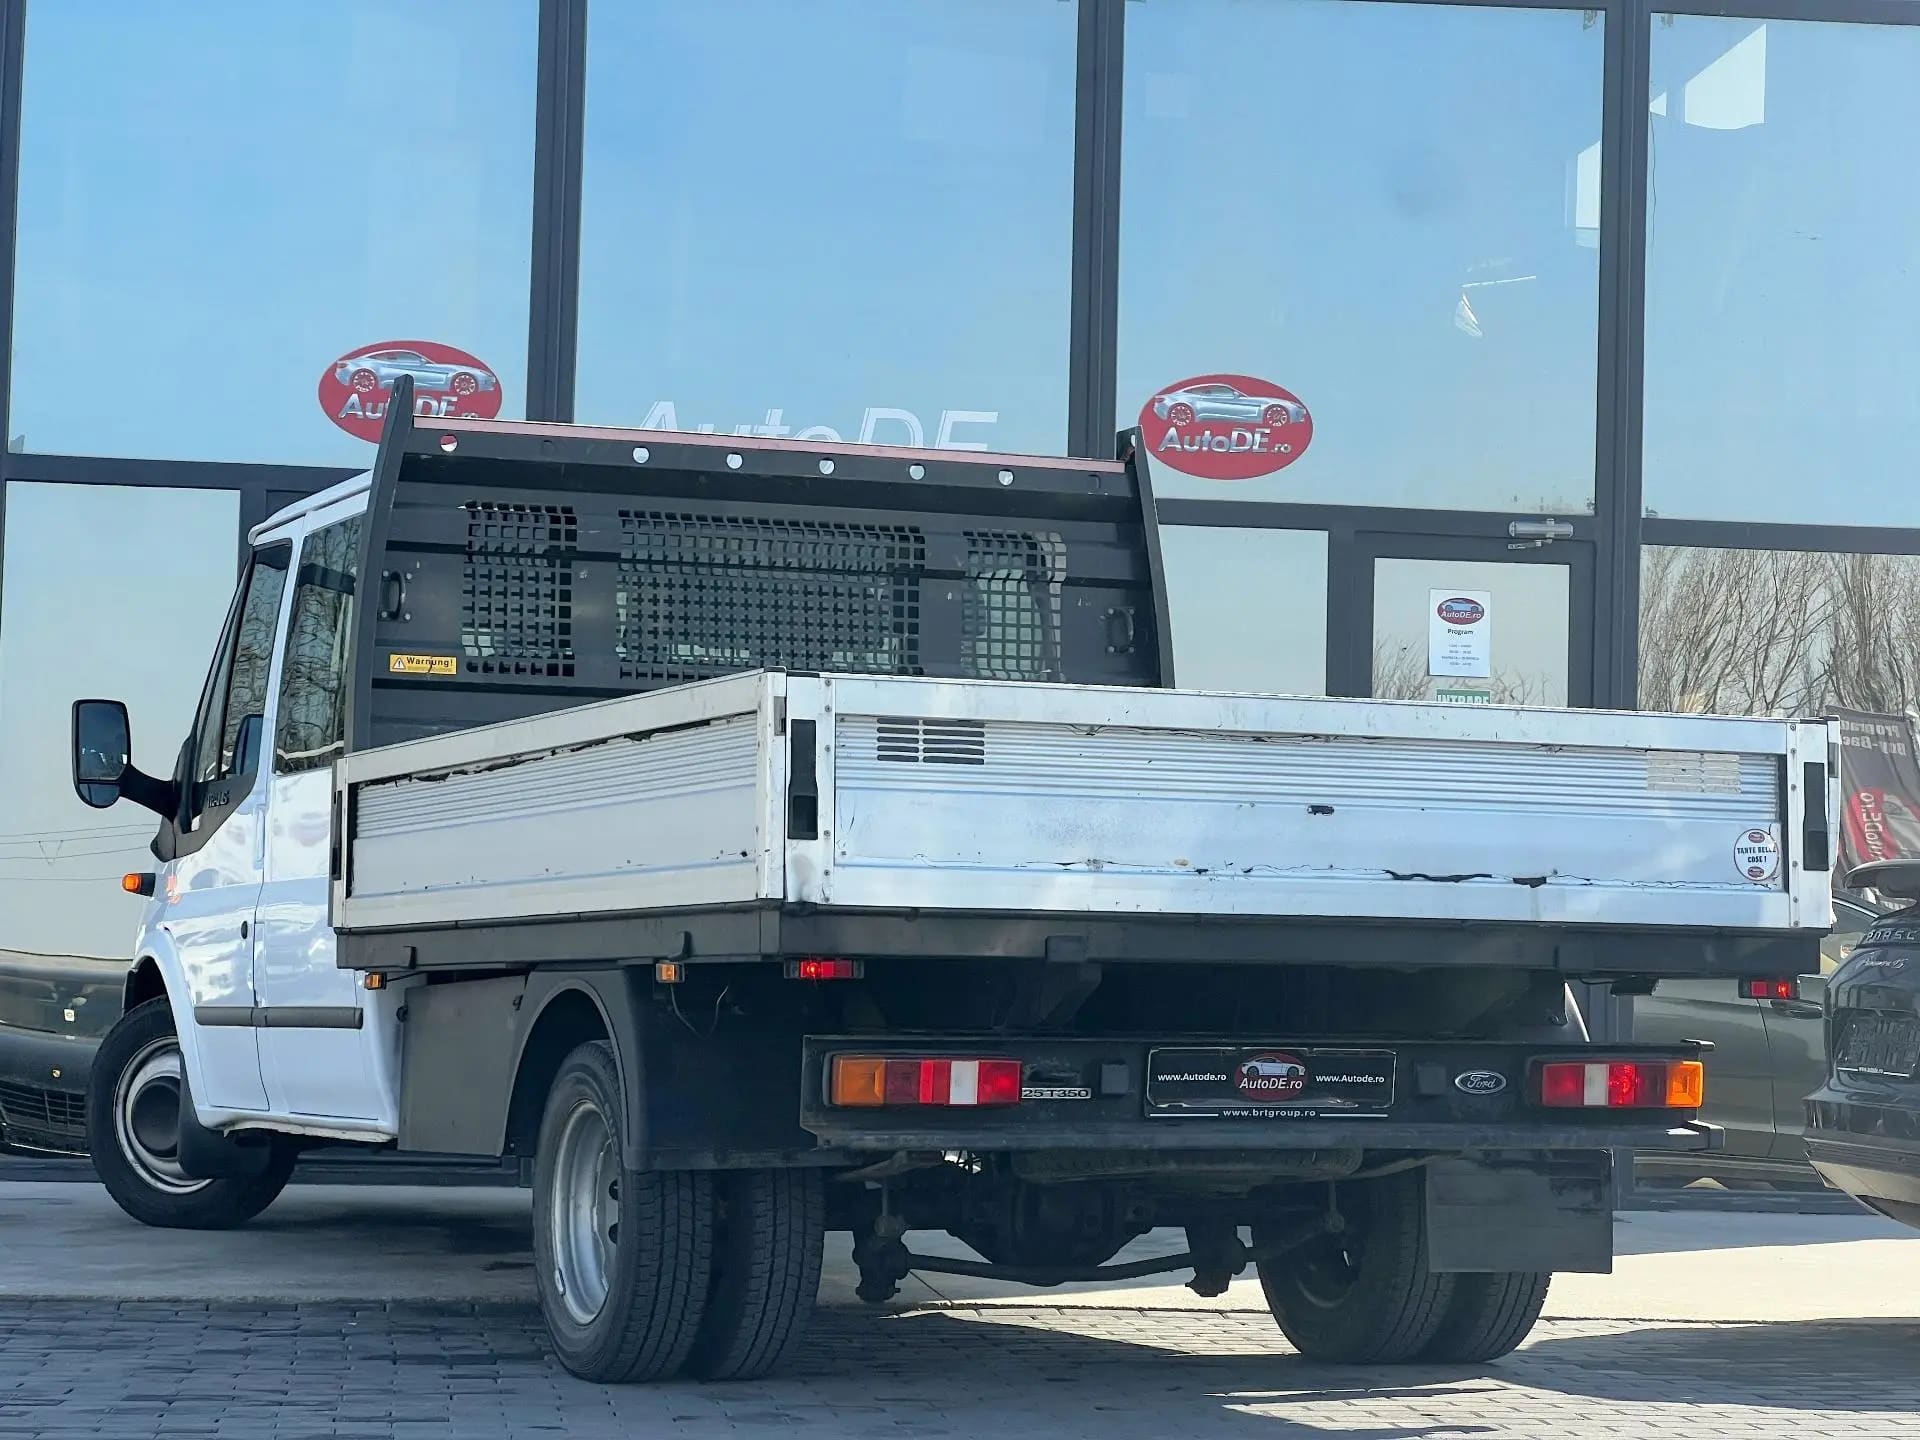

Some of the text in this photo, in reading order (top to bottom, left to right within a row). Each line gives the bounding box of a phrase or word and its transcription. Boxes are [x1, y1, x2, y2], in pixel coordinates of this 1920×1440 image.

[1447, 628, 1474, 636] Program
[406, 656, 453, 667] Warnung!
[1866, 929, 1918, 941] PORSC
[1157, 1072, 1227, 1082] www.Autode.ro
[1315, 1074, 1385, 1083] www.Autode.ro
[1467, 1074, 1497, 1088] Ford
[1239, 1077, 1303, 1090] AutoDE.ro
